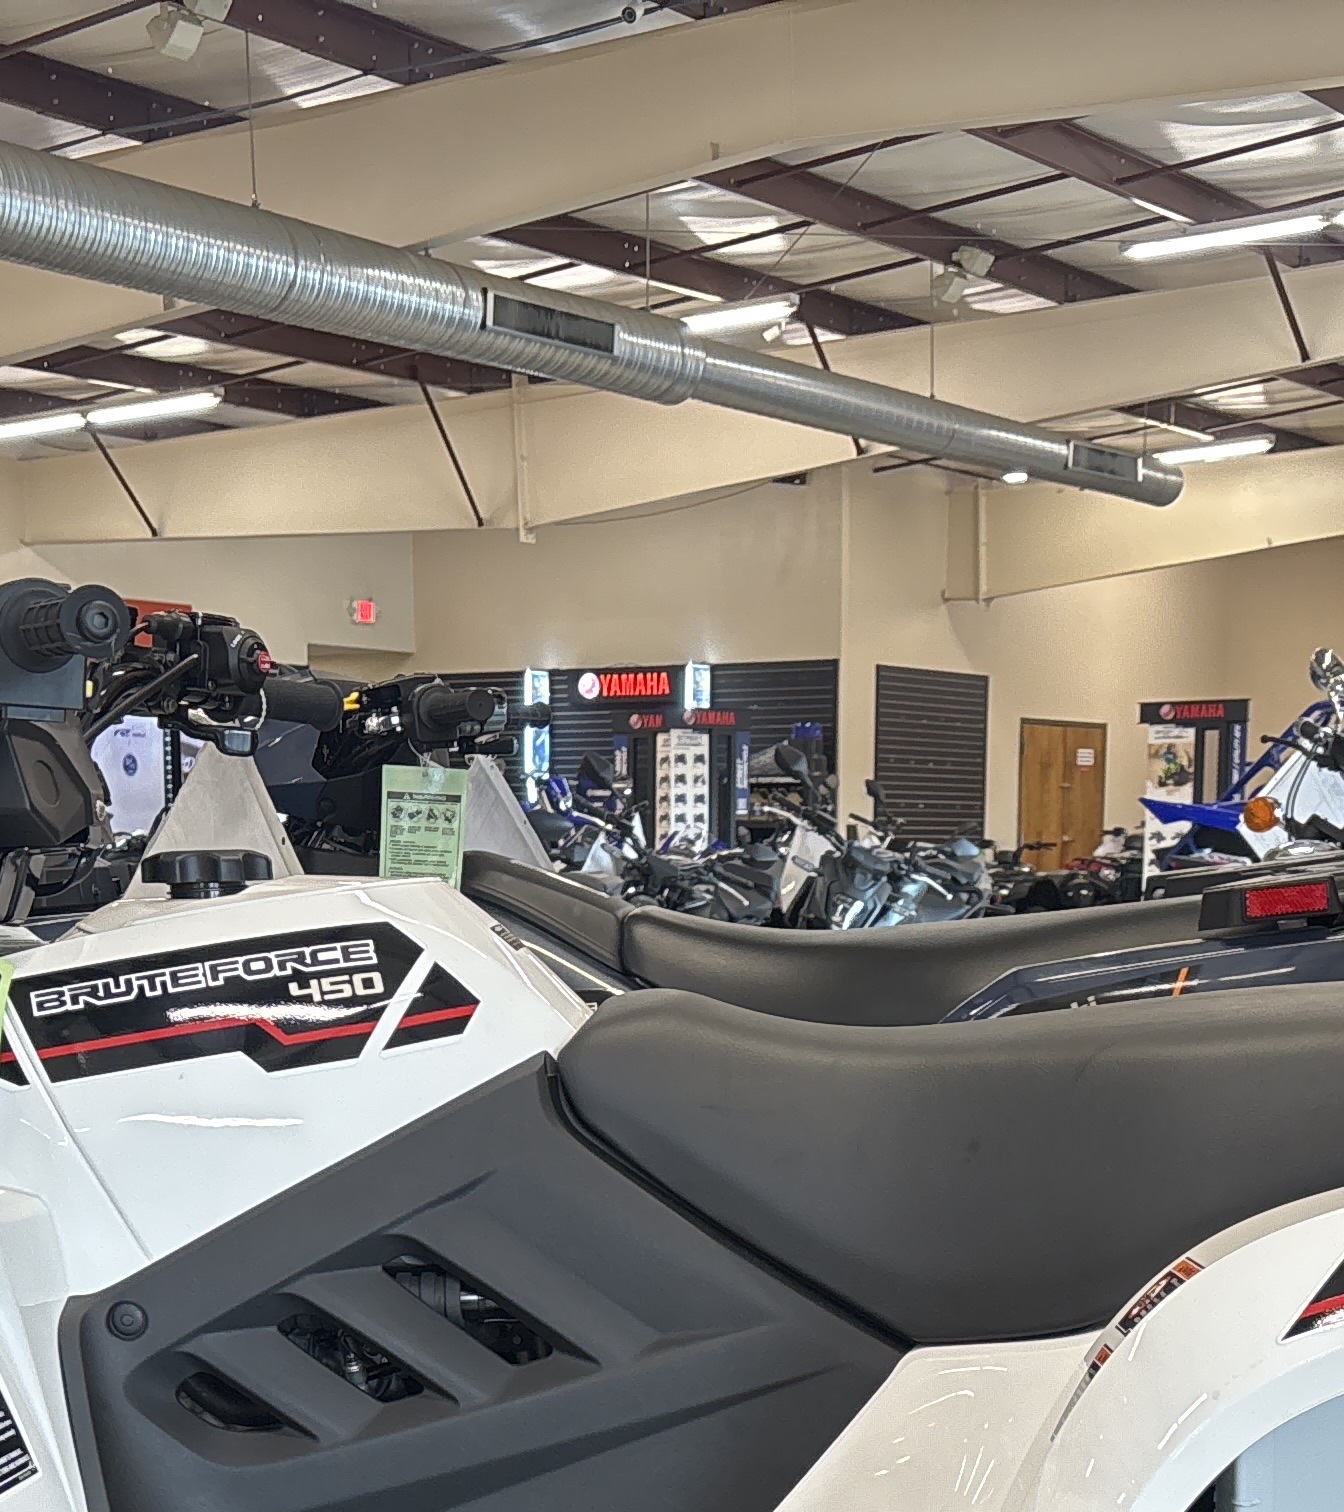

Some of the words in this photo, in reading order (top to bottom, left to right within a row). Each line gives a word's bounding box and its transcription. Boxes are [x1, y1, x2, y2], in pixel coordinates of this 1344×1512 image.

[599, 671, 670, 697] YAMAHA
[696, 710, 736, 725] YAMAHA
[1175, 703, 1225, 719] YAMAHA
[29, 962, 206, 1018] BRUTE
[204, 939, 377, 984] FORCE
[288, 971, 385, 1003] 450
